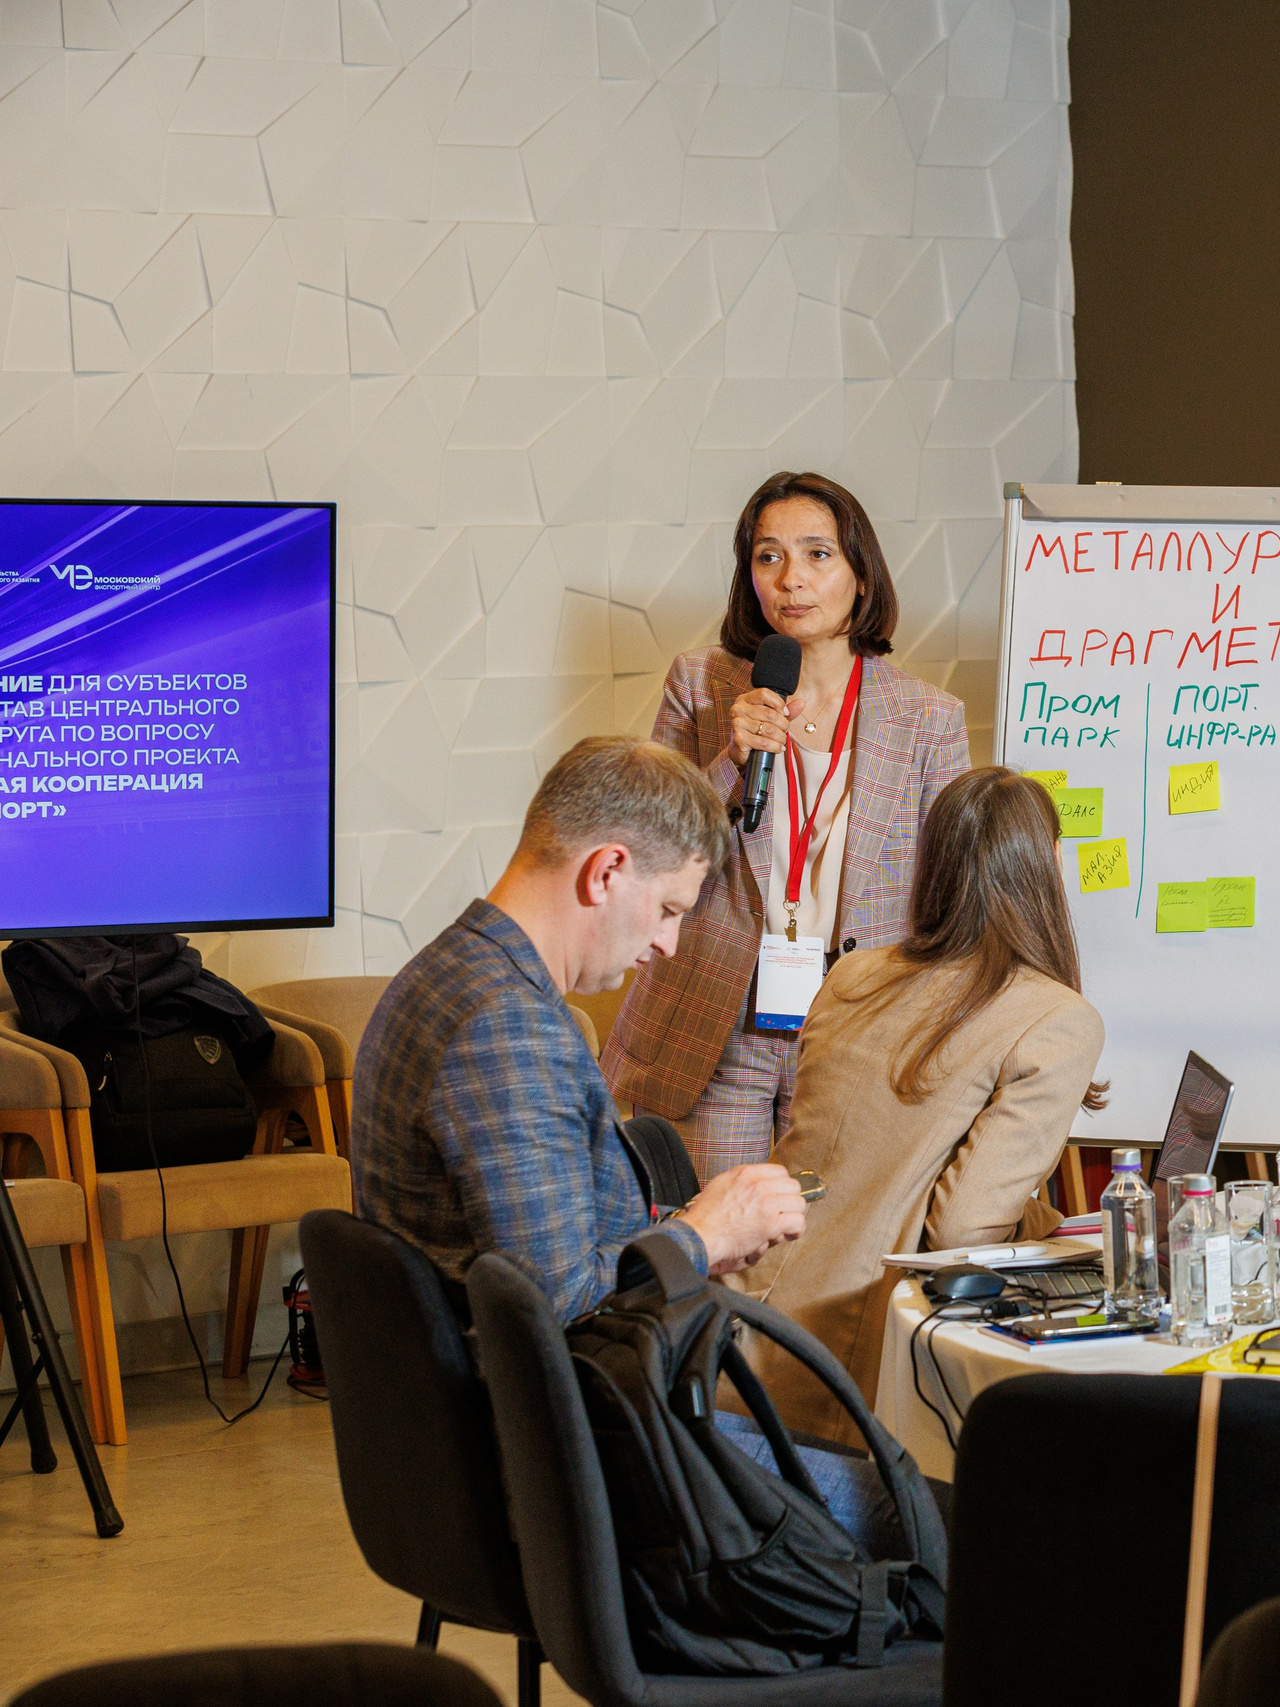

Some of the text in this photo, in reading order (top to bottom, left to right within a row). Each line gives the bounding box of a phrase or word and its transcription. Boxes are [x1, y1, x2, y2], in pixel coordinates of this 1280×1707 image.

[1211, 583, 1241, 624] И
[47, 675, 100, 695] ДЛЯ
[106, 673, 247, 692] СУБЪЕКТОВ
[51, 698, 240, 720] ЦЕНТРАЛЬНОГО
[61, 725, 95, 742] ПО
[101, 723, 215, 742] ВОПРОСУ
[1023, 726, 1121, 748] ПАРК
[134, 748, 240, 766] ПРОЕКТА
[32, 773, 203, 793] КООПЕРАЦИЯ
[0, 802, 67, 819] ОРТ»
